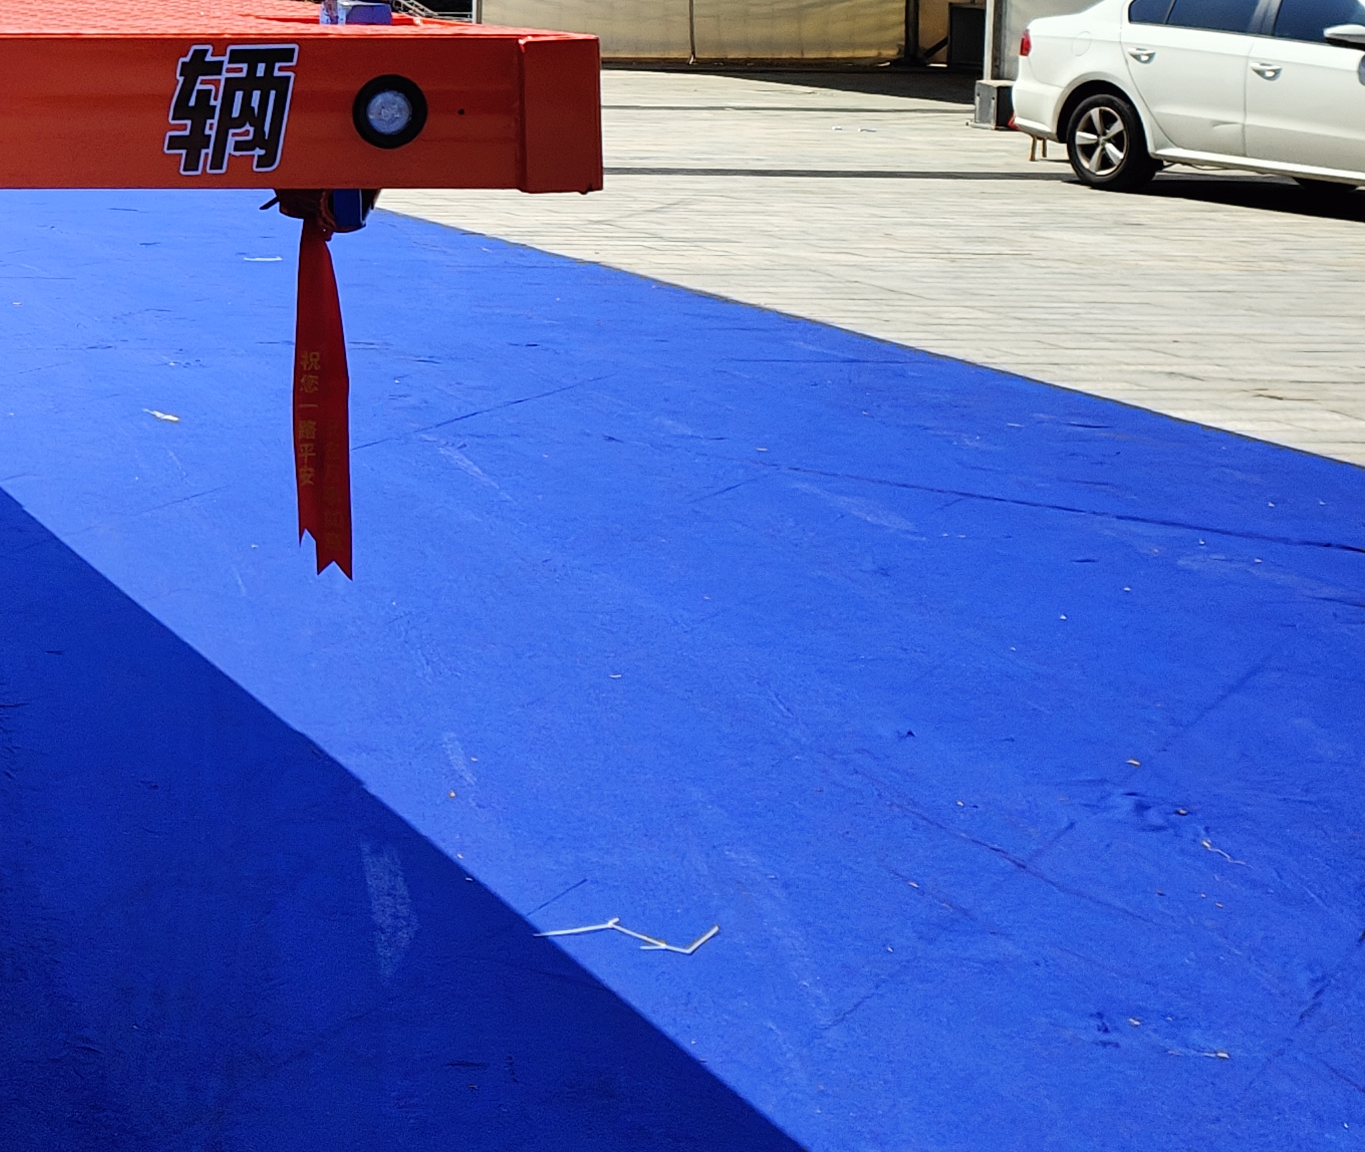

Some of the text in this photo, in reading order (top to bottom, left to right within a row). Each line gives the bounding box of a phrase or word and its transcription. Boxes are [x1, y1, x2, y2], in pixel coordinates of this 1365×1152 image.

[298, 350, 321, 487] 祝您一路平安
